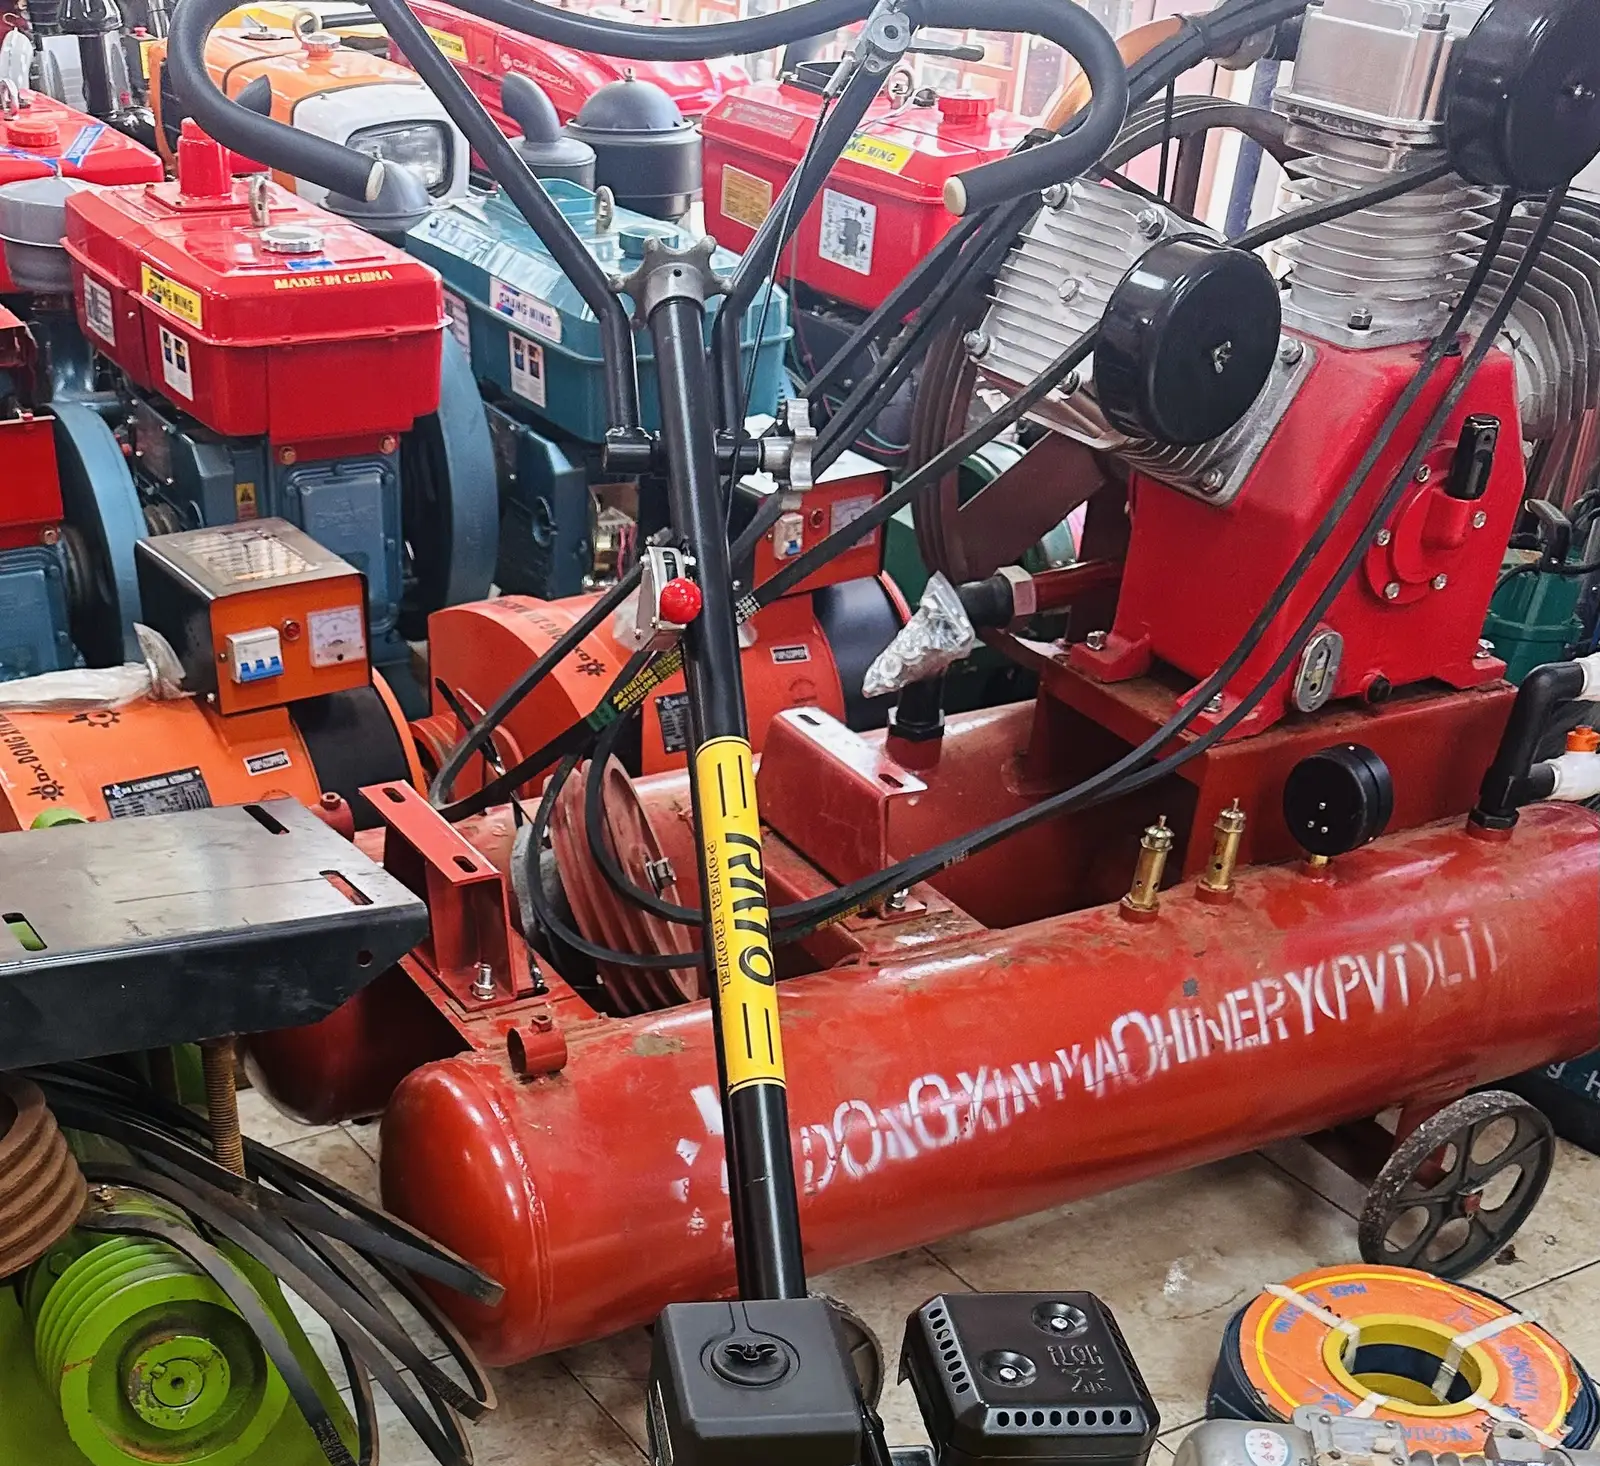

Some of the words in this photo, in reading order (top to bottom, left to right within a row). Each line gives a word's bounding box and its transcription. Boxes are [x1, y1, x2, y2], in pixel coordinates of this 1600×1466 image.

[273, 275, 323, 290] MADE
[324, 273, 342, 286] IN
[343, 269, 393, 285] CHINA
[707, 841, 723, 911] POWER
[725, 832, 775, 986] RATO
[714, 913, 732, 994] TROWEL
